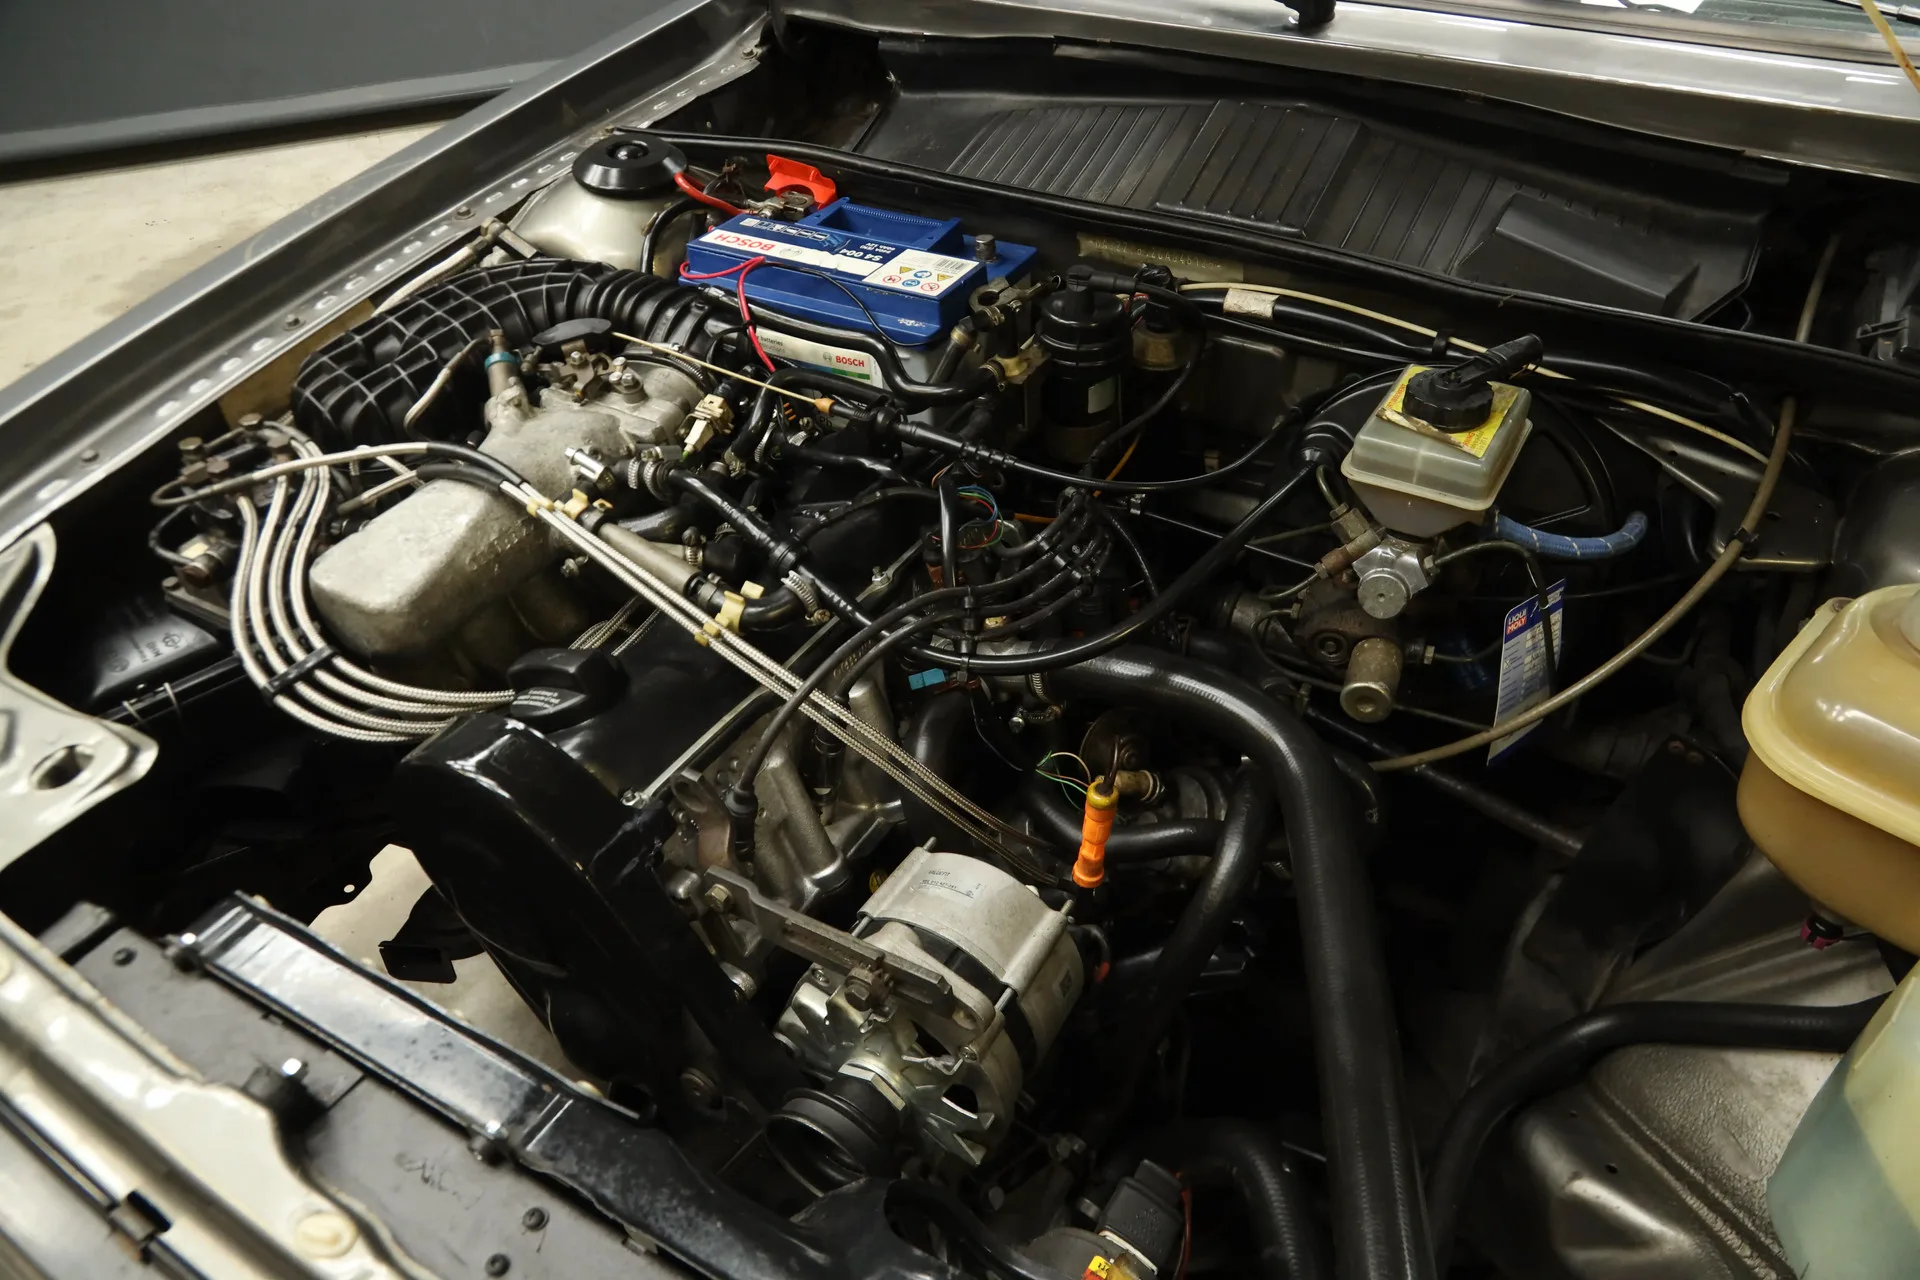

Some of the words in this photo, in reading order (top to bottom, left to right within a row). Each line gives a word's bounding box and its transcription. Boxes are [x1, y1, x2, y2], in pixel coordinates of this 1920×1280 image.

[714, 233, 776, 251] BOSCH
[838, 248, 864, 258] 004
[864, 253, 883, 261] S4
[835, 355, 865, 367] BOSCH
[1506, 616, 1527, 635] MOLY
